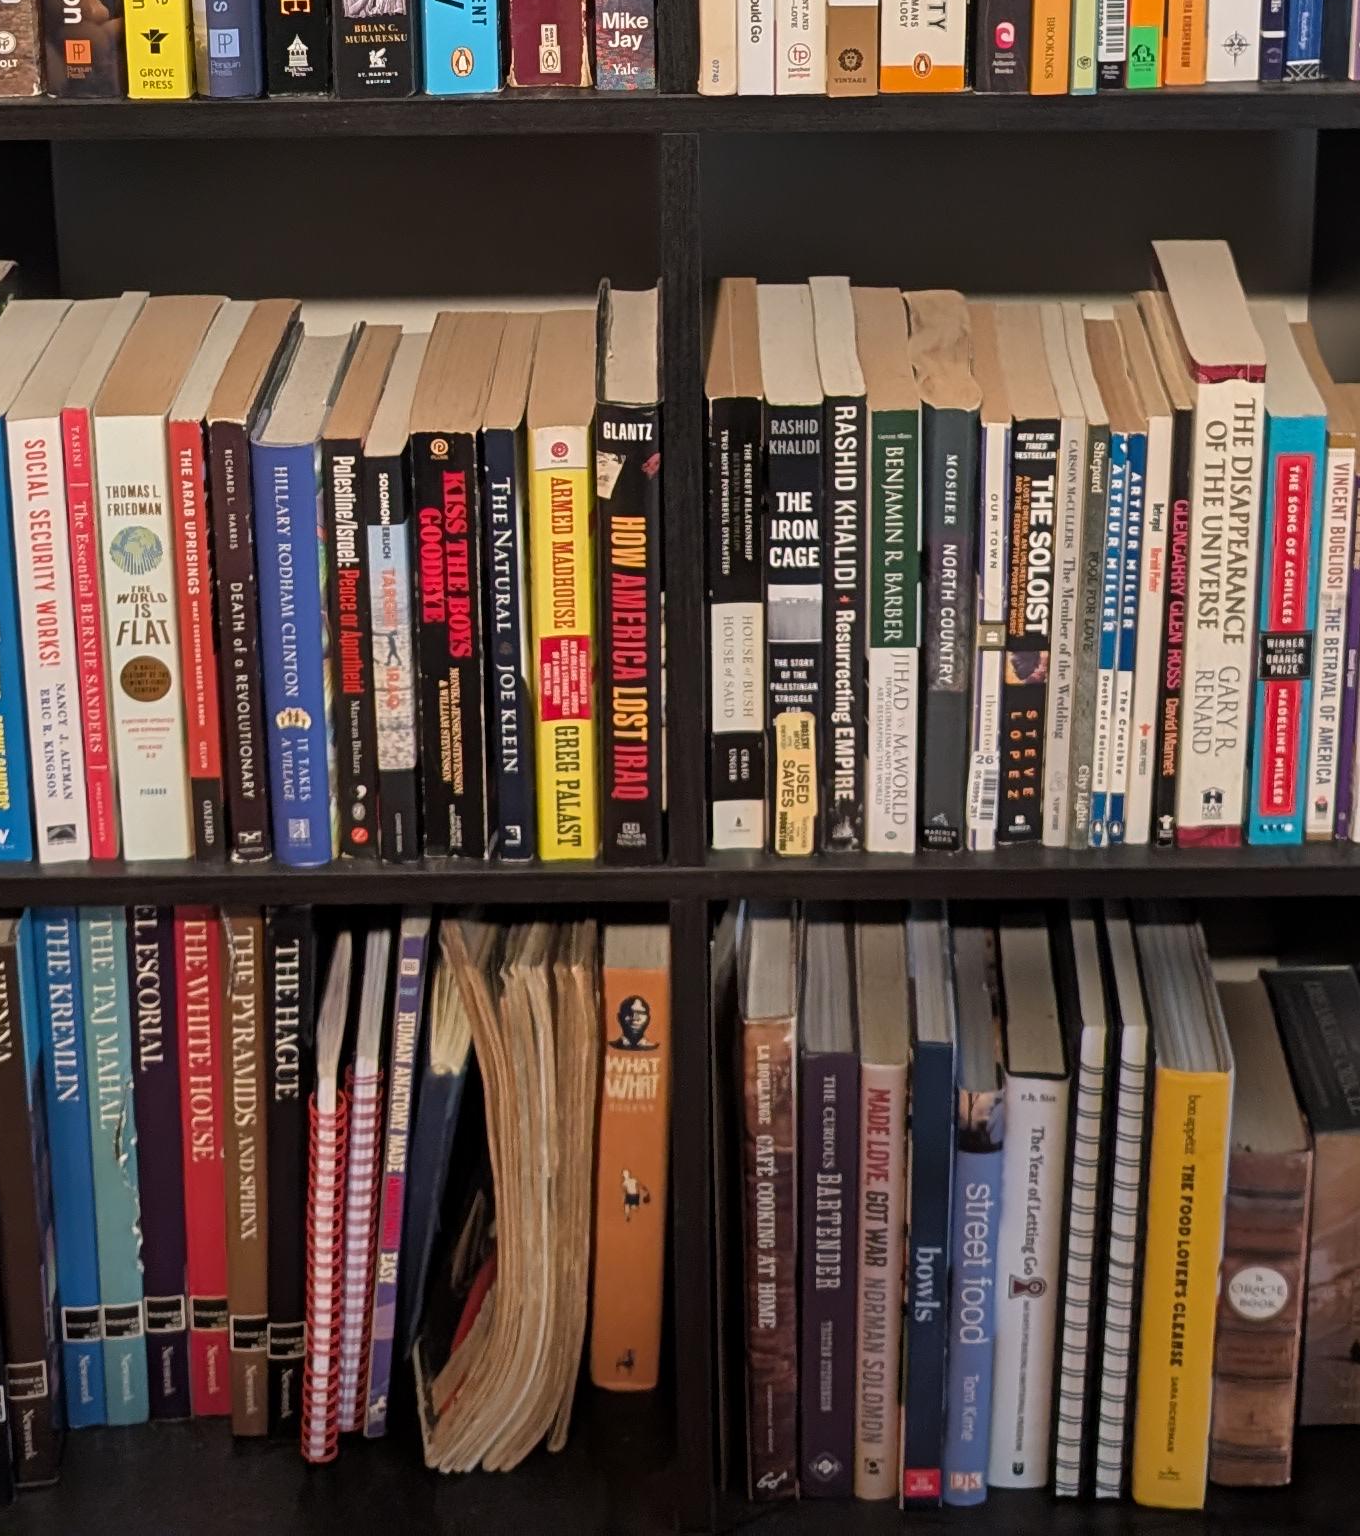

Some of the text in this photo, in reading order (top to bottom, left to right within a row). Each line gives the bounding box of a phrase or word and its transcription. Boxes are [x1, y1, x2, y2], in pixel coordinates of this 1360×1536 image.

[602, 13, 649, 30] Mike
[609, 31, 643, 51] Jay
[140, 68, 174, 77] GROVE
[143, 80, 173, 90] PRESS
[603, 422, 652, 441] GLANTZ
[771, 420, 818, 435] RASHID
[769, 440, 820, 455] KHALIDI
[106, 485, 160, 500] THOMAS L.
[776, 493, 812, 512] THE
[107, 501, 162, 517] FRIEDMAN
[770, 519, 819, 540] IRON
[770, 547, 819, 567] CAGE
[117, 621, 171, 646] FLAT
[610, 516, 649, 801] HOW AMERICA LOST IRAQ
[782, 760, 796, 808] SAVES
[797, 765, 810, 805] USED
[44, 921, 81, 1102] THE KREMLIN
[275, 939, 300, 1102] THE HAGUE
[962, 1183, 992, 1345] street food
[914, 1247, 940, 1323] bowls
